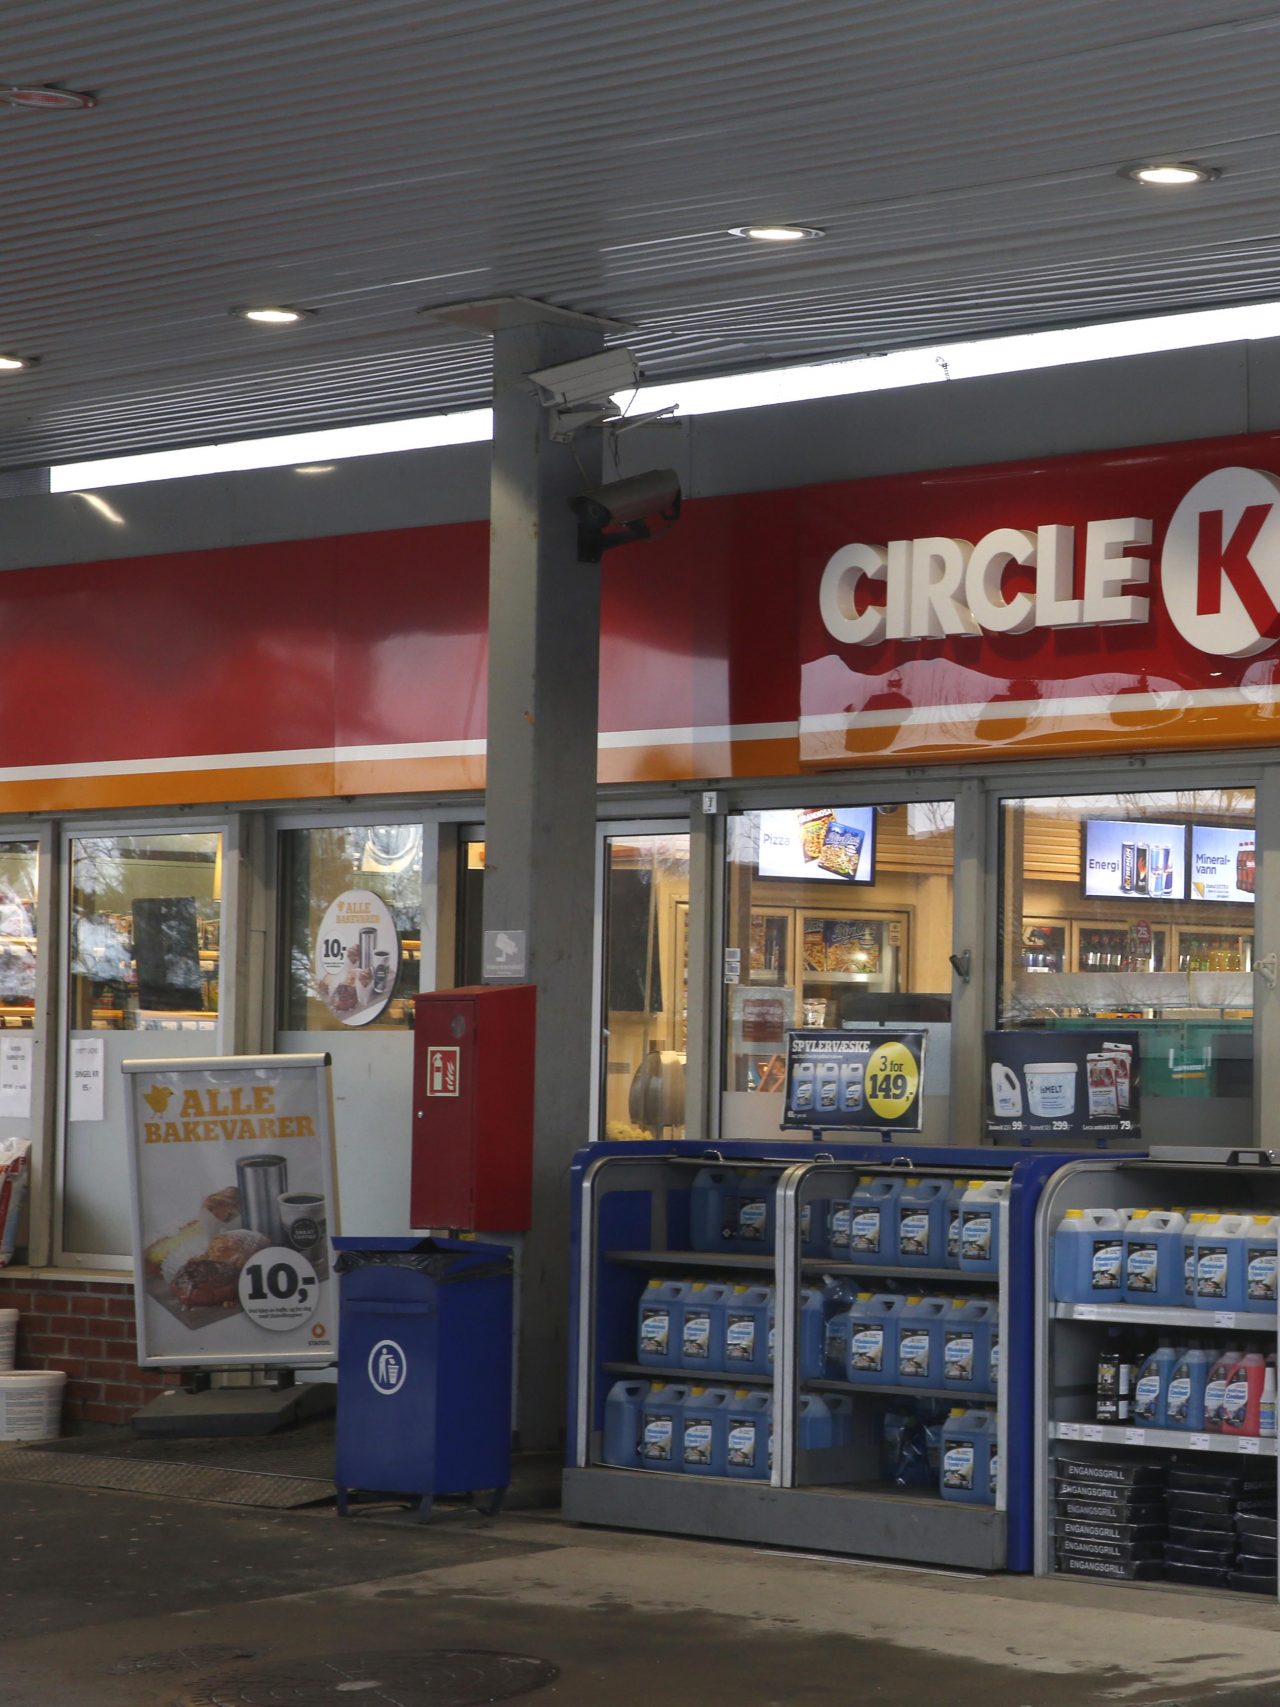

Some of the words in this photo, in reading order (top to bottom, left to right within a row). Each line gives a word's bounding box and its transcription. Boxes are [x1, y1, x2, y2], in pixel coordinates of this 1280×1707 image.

[819, 516, 1153, 646] CIRCLE
[763, 833, 791, 846] Pizza
[1089, 859, 1120, 872] Energi
[1196, 853, 1231, 865] Mineral-
[1196, 865, 1217, 875] vann
[346, 902, 372, 914] ALLE
[323, 939, 347, 960] 10,-
[791, 1040, 871, 1053] SPYLERVÆSKE
[879, 1056, 888, 1072] 3
[890, 1060, 904, 1072] for
[868, 1074, 914, 1102] 149,-
[179, 1085, 277, 1118] ALLE
[143, 1115, 315, 1144] BAKEVARER
[246, 1262, 315, 1304] 10,-
[1064, 1523, 1121, 1538] ENGANGSGRILL
[1064, 1541, 1121, 1556] ENGANGSGRILL
